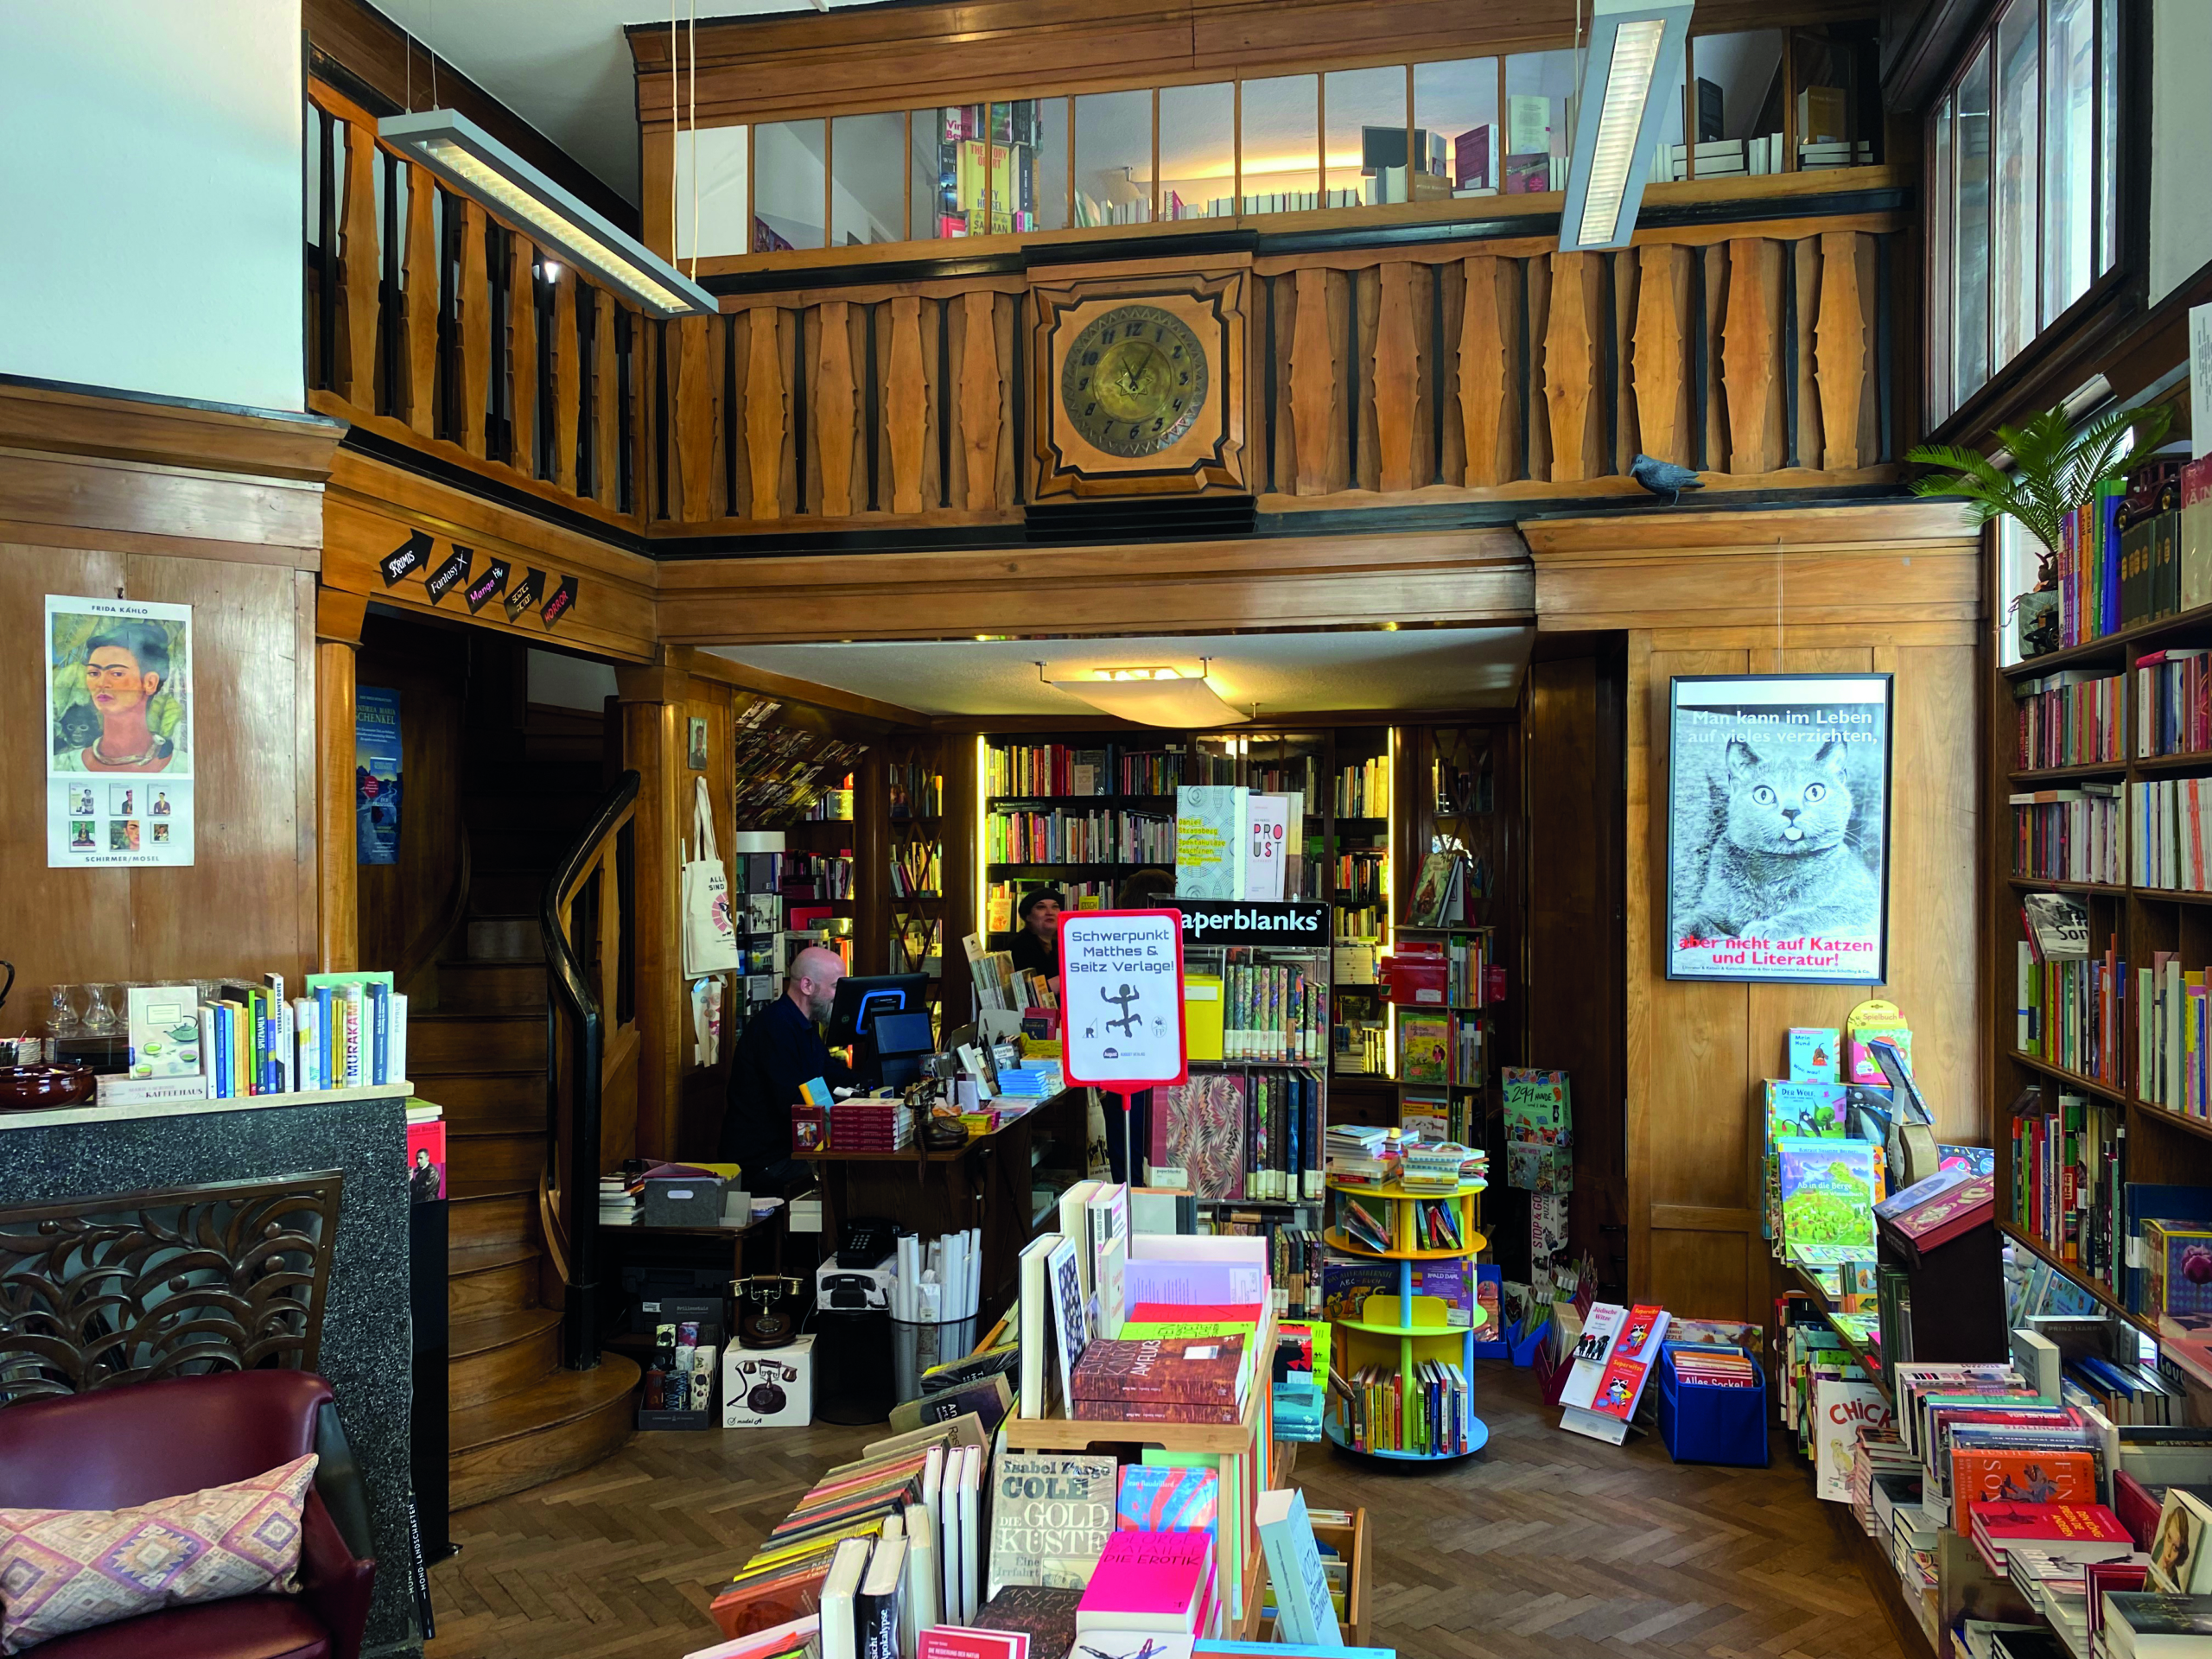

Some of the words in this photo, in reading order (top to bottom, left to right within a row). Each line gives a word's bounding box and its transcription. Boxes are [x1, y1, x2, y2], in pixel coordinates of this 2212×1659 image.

[970, 143, 983, 156] THE
[1102, 329, 1116, 345] 11
[1126, 322, 1143, 337] 12
[1155, 329, 1164, 343] 1
[1082, 351, 1099, 366] 10
[1172, 346, 1183, 359] 2
[1079, 377, 1090, 391] 9
[1179, 372, 1189, 386] 3
[1085, 402, 1096, 416] 8
[1172, 398, 1183, 412] 4
[1103, 420, 1115, 434] 7
[1129, 424, 1141, 440] 6
[1152, 417, 1165, 432] 5
[430, 563, 459, 594] Fantasy
[469, 578, 496, 605] Manga
[544, 590, 569, 623] HORROR
[1692, 710, 1730, 725] Man
[1737, 710, 1780, 725] kann
[1785, 710, 1809, 724] im
[1816, 709, 1872, 724] Leben
[1688, 729, 1717, 743] auf
[1720, 729, 1770, 743] vieles
[1777, 728, 1878, 745] verzichten,
[1179, 817, 1202, 826] Daniel
[1181, 909, 1319, 938] aperblanks
[1071, 929, 1170, 944] Schwerpunkt
[1679, 935, 1717, 949] aber
[1726, 936, 1770, 950] nicht
[1777, 937, 1805, 950] auf
[1809, 937, 1873, 952] Katzen
[1083, 945, 1142, 957] Matthes
[1147, 946, 1159, 956] &
[1712, 951, 1745, 964] und
[1752, 951, 1840, 967] Literatur!
[1070, 962, 1108, 973] Seitz
[1112, 960, 1174, 975] Verlage!
[1863, 1013, 1897, 1021] Spielbuch
[346, 1000, 359, 1077] MURAKAMI
[1085, 1027, 1095, 1038] R
[145, 1088, 203, 1098] KAFFEEHAUS
[1512, 1085, 1535, 1104] 299
[1535, 1092, 1552, 1102] HUNDE
[1832, 1182, 1853, 1191] Berge
[1533, 1212, 1541, 1221] &
[1532, 1221, 1543, 1249] STOP
[1595, 1313, 1611, 1322] Witze
[1613, 1359, 1643, 1372] Superwitze
[1685, 1376, 1708, 1385] Alles
[1002, 1460, 1057, 1475] Isabel
[1001, 1476, 1089, 1501] COLE
[1141, 1479, 1175, 1488] Baudrillard
[1000, 1516, 1022, 1527] DIE
[1024, 1501, 1109, 1529] GOLD
[2076, 1510, 2092, 1522] DEN
[2084, 1521, 2105, 1538] KÖNIG
[996, 1528, 1108, 1555] KÜSTE
[1015, 1556, 1040, 1567] Eine
[1103, 1554, 1132, 1563] DIE
[1137, 1555, 1201, 1566] EROTIK
